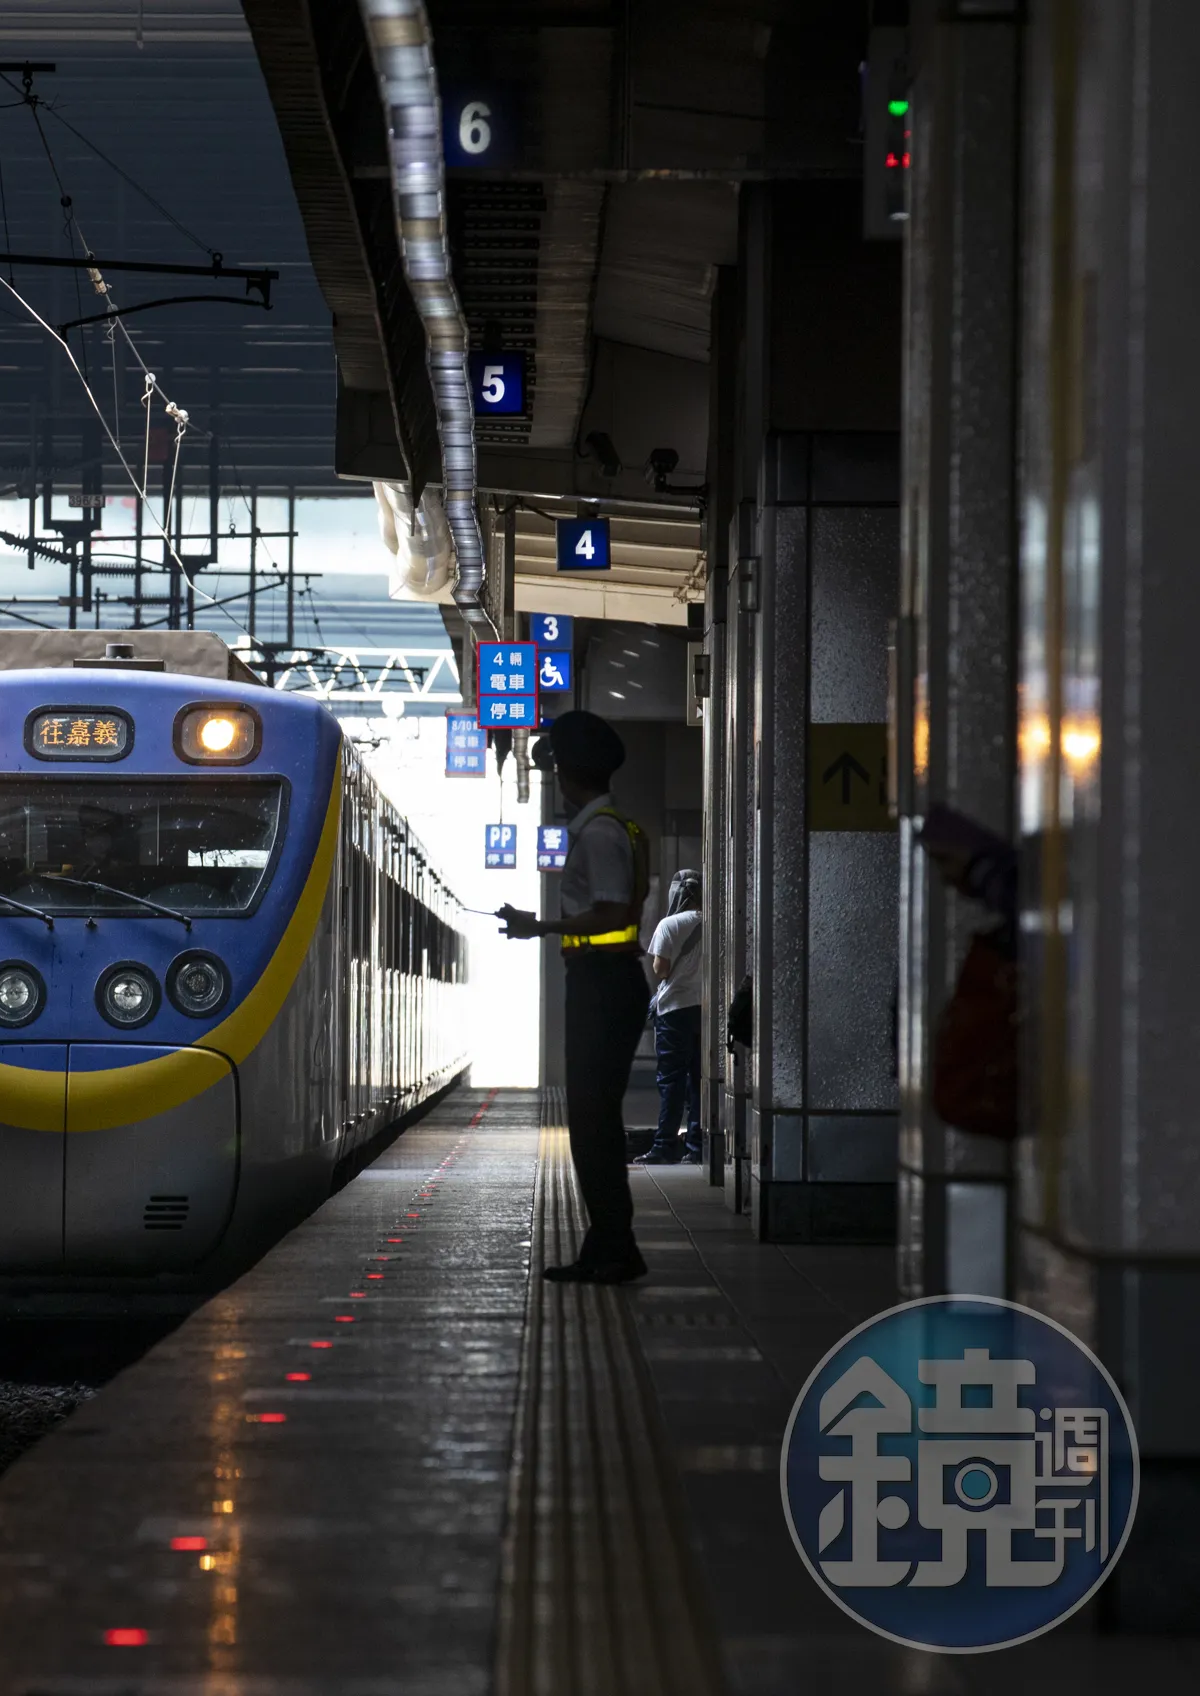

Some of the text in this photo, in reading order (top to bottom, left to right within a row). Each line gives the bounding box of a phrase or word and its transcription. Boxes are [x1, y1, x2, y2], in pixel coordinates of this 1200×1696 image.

[458, 101, 492, 155] 6
[482, 364, 505, 403] 5
[575, 529, 595, 560] 4
[543, 616, 559, 641] 3
[489, 673, 525, 691] 電車
[490, 702, 525, 720] 停車
[40, 719, 118, 746] 往嘉義
[490, 826, 512, 848] PP
